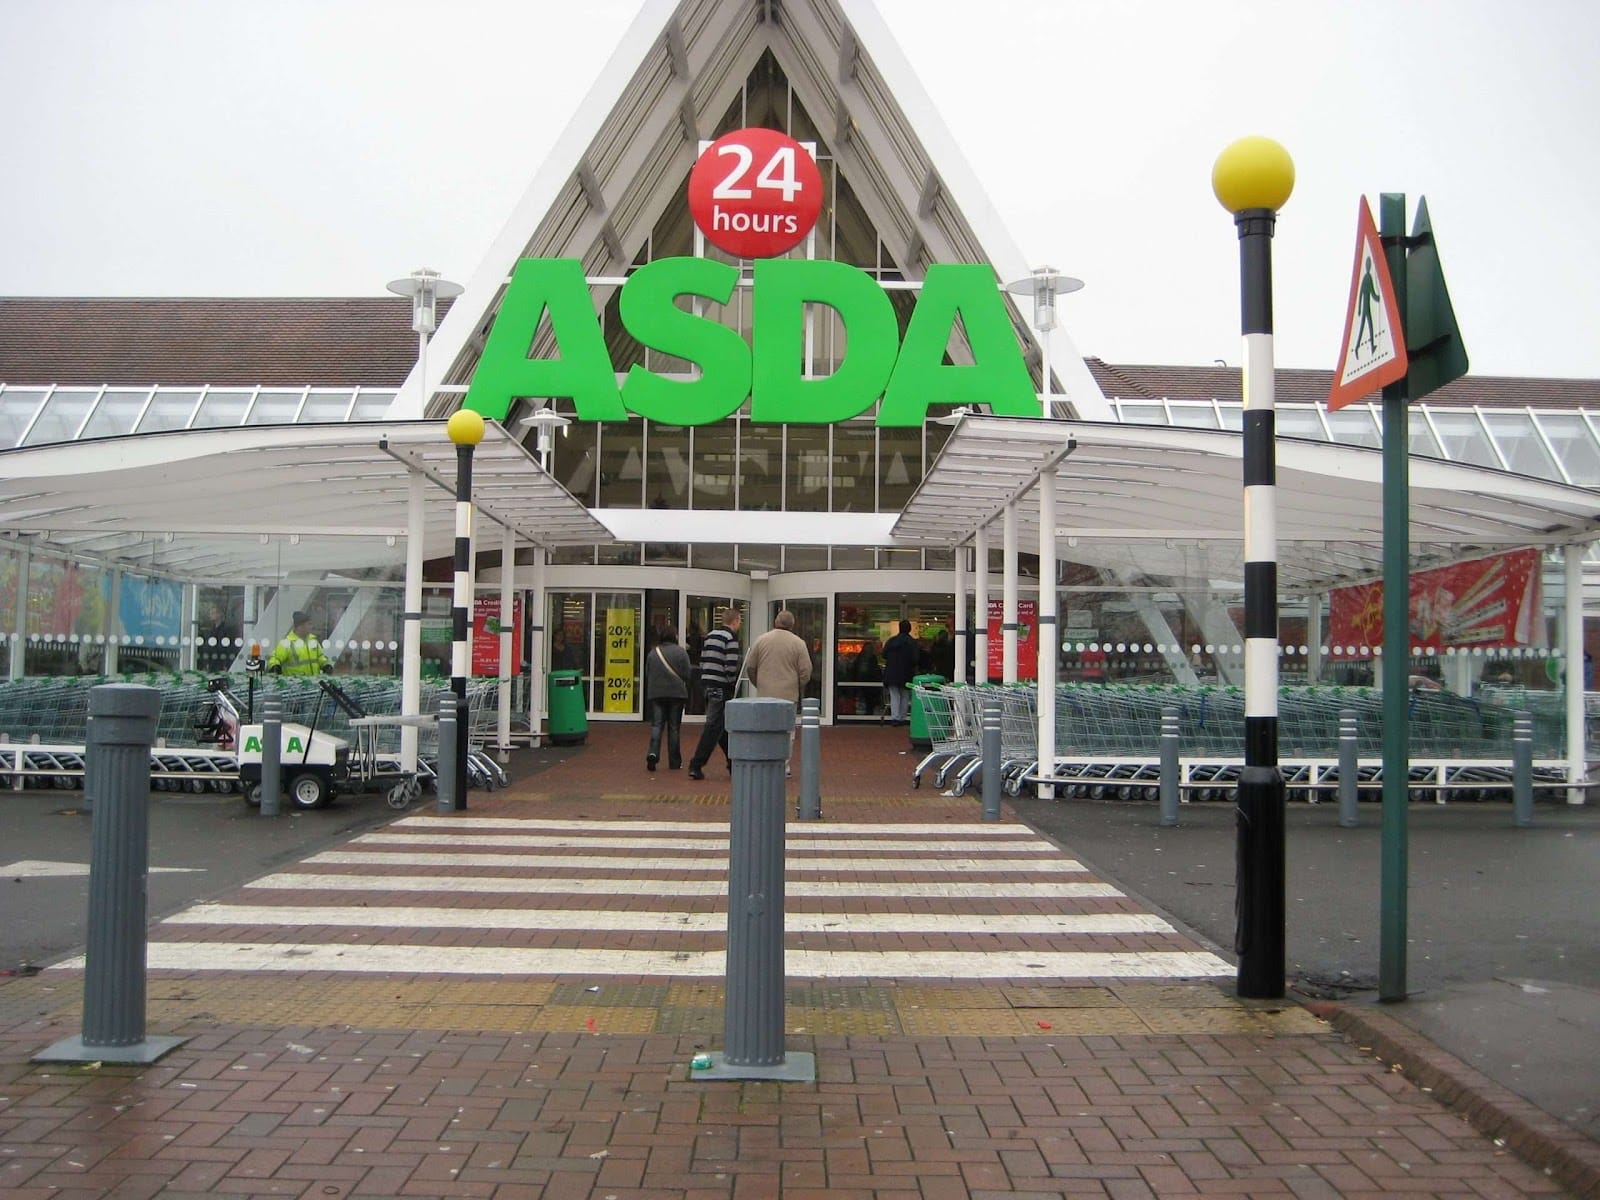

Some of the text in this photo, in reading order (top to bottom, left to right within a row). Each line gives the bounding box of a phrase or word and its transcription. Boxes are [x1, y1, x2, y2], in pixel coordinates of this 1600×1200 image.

[713, 144, 802, 202] 24
[713, 205, 797, 234] hours
[462, 256, 1042, 427] ASDA
[608, 626, 632, 636] 20%
[612, 638, 628, 648] off
[608, 678, 631, 688] 20%
[611, 690, 627, 700] off
[244, 736, 303, 753] AA
